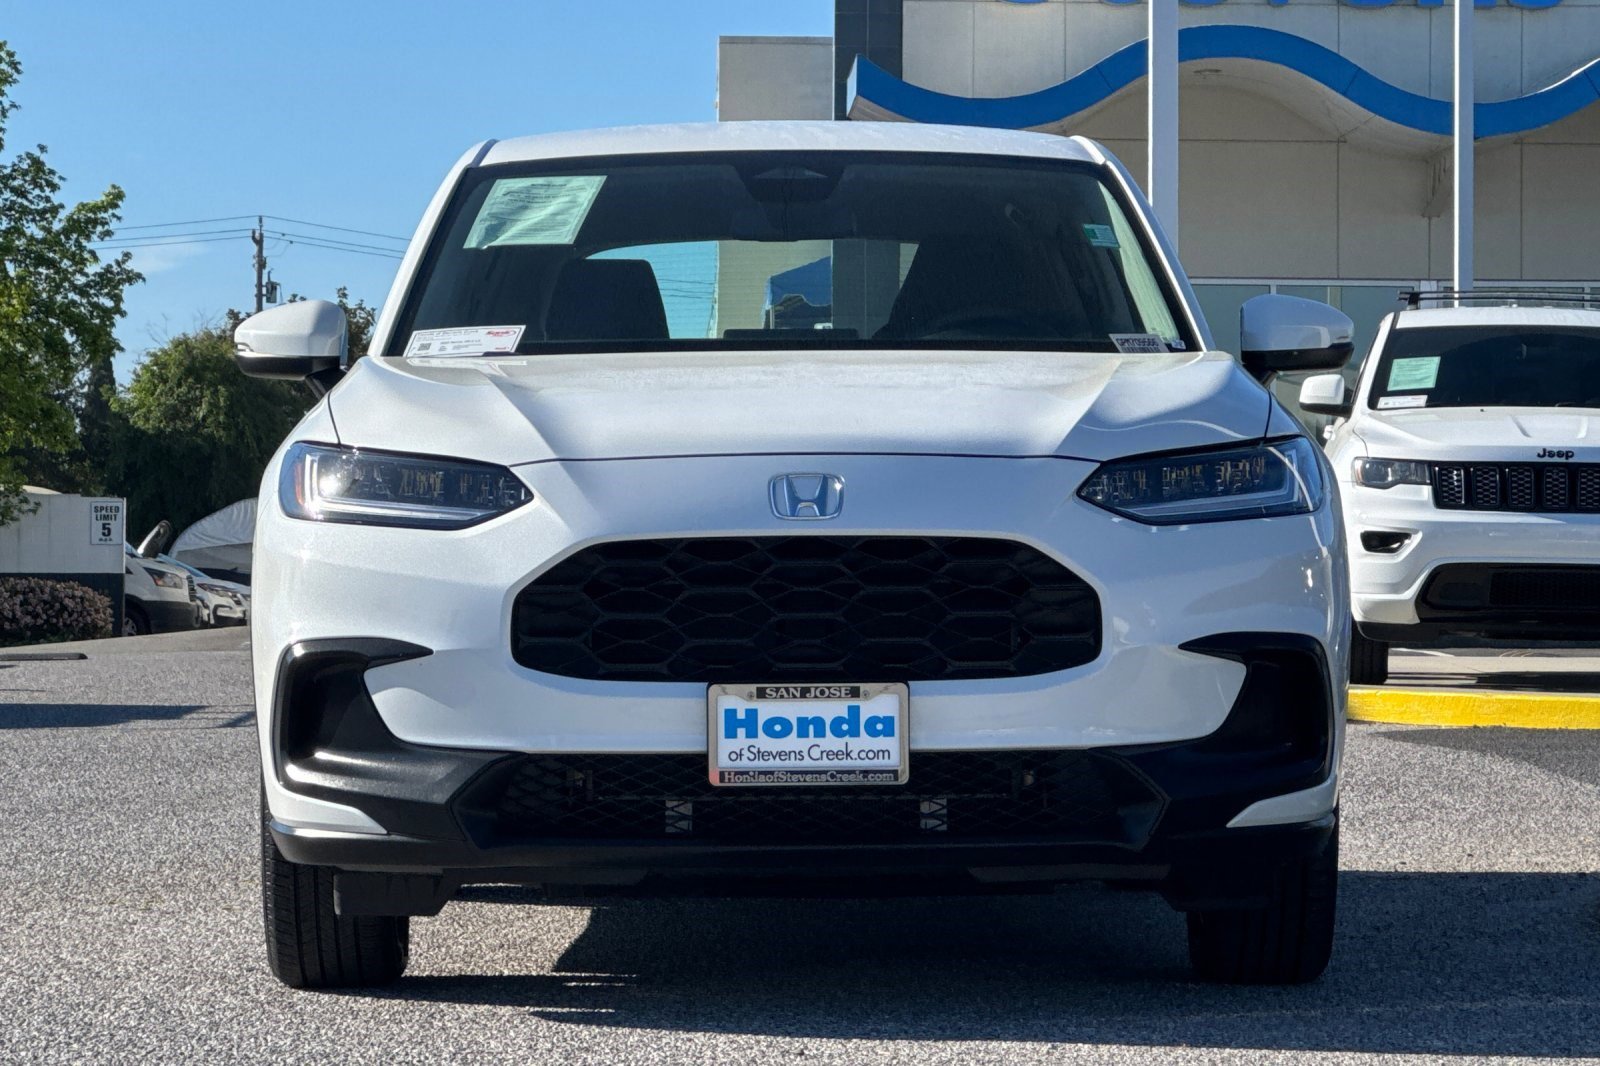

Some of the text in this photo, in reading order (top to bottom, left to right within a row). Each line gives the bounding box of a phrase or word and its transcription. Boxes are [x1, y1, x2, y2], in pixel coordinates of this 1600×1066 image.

[1537, 448, 1574, 460] Jeep
[101, 523, 111, 537] 5
[765, 687, 851, 699] SAN JOSE
[724, 705, 895, 739] Honda
[728, 742, 891, 762] of Stevens Creek.com
